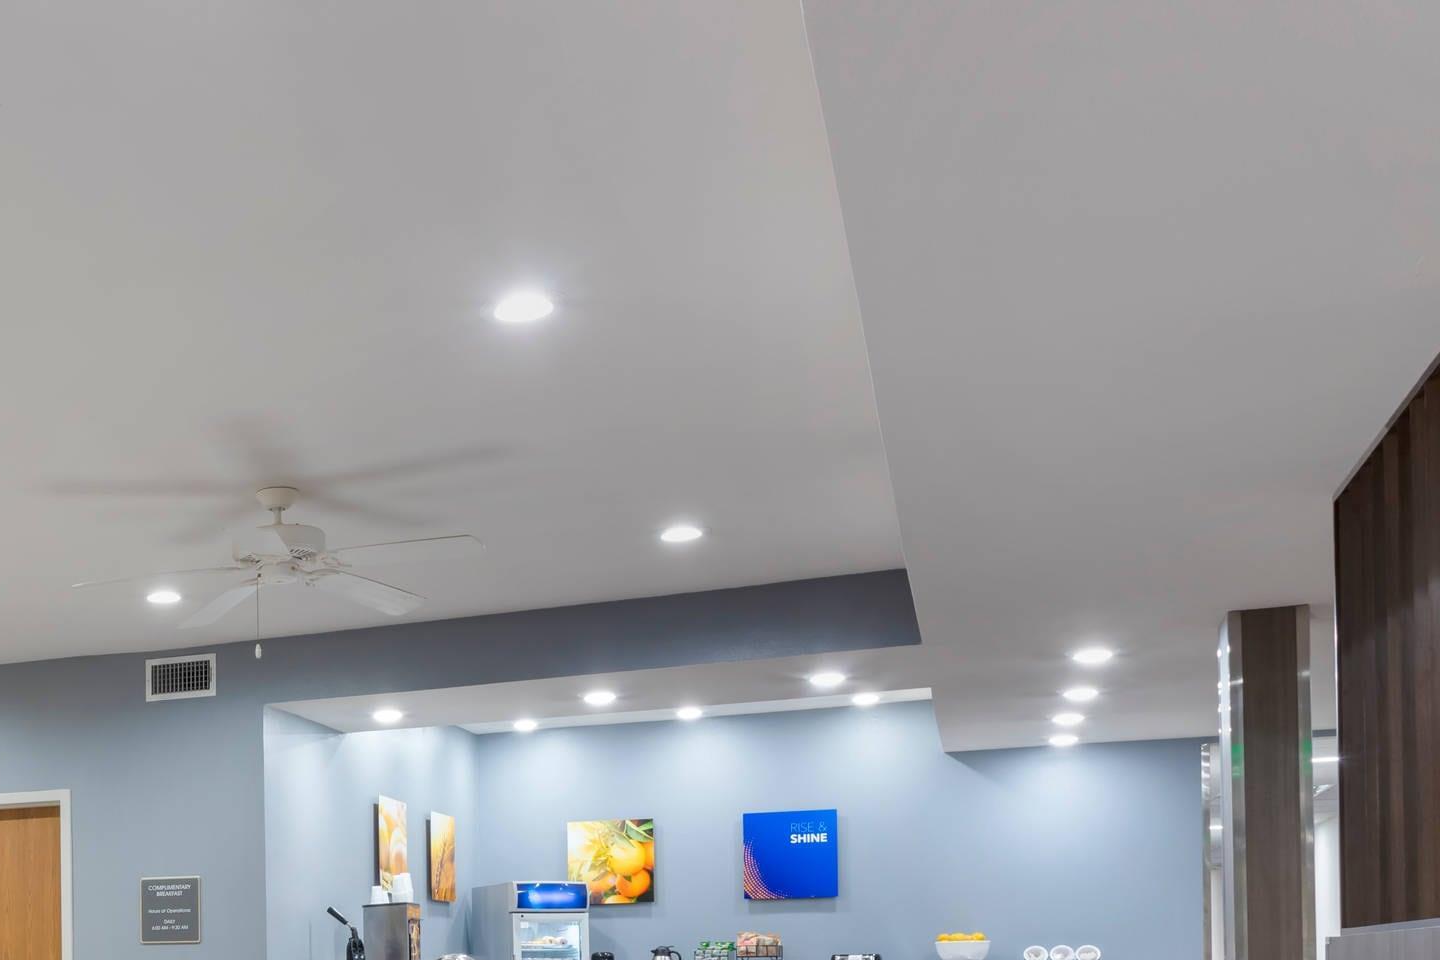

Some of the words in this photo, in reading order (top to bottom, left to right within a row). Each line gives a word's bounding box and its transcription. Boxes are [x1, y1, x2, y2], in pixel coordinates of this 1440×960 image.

[790, 822, 814, 832] RISE
[818, 820, 827, 832] &
[790, 833, 828, 844] SHINE
